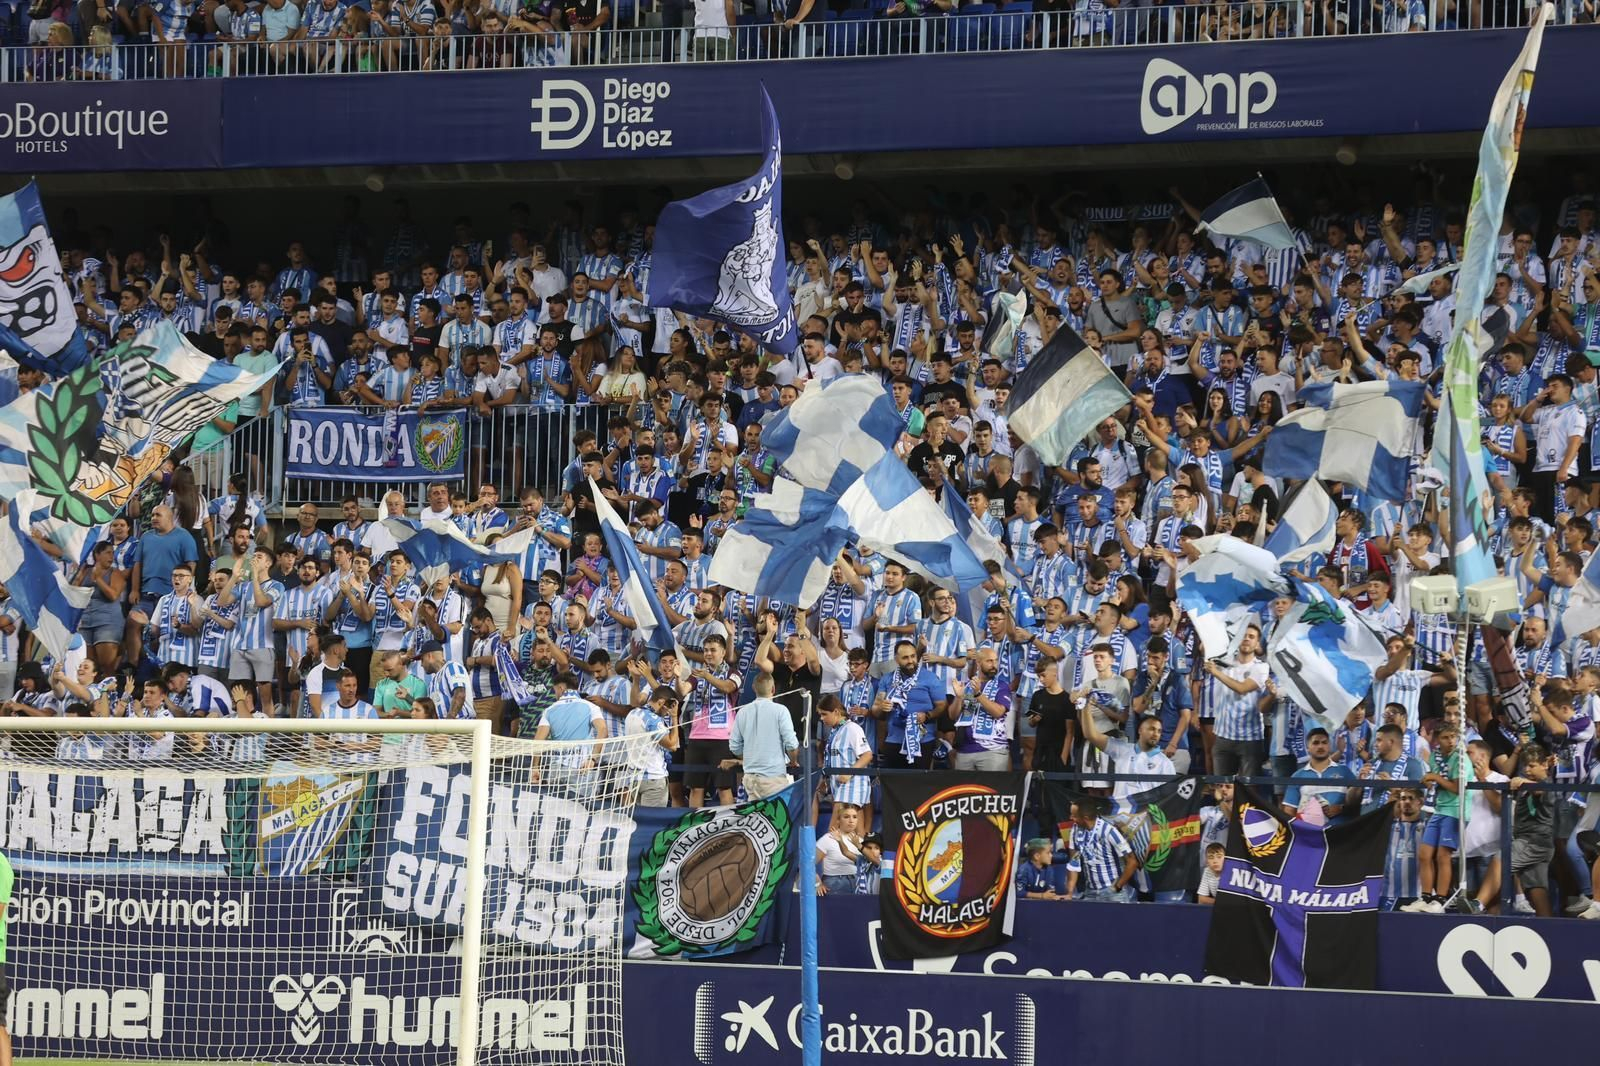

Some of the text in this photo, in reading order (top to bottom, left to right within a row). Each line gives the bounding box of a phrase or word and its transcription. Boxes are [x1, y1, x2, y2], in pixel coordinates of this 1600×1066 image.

[604, 78, 671, 104] Diego
[603, 102, 654, 124] Díaz
[1196, 119, 1325, 132] PREVENCIÓN DE RIESGOS LABORALES
[16, 140, 68, 153] HOTELS
[603, 126, 673, 151] López
[288, 419, 416, 467] RONDA
[976, 710, 988, 732] MUY
[908, 734, 921, 755] MUY
[393, 765, 638, 890] FONDO
[901, 795, 1018, 831] EL PERCHEL
[84, 889, 251, 927] Provincial
[493, 880, 619, 950] 1904
[660, 877, 717, 941] DESDE 1904
[350, 977, 589, 1052] hummel
[787, 1003, 1009, 1060] CaixaBank
